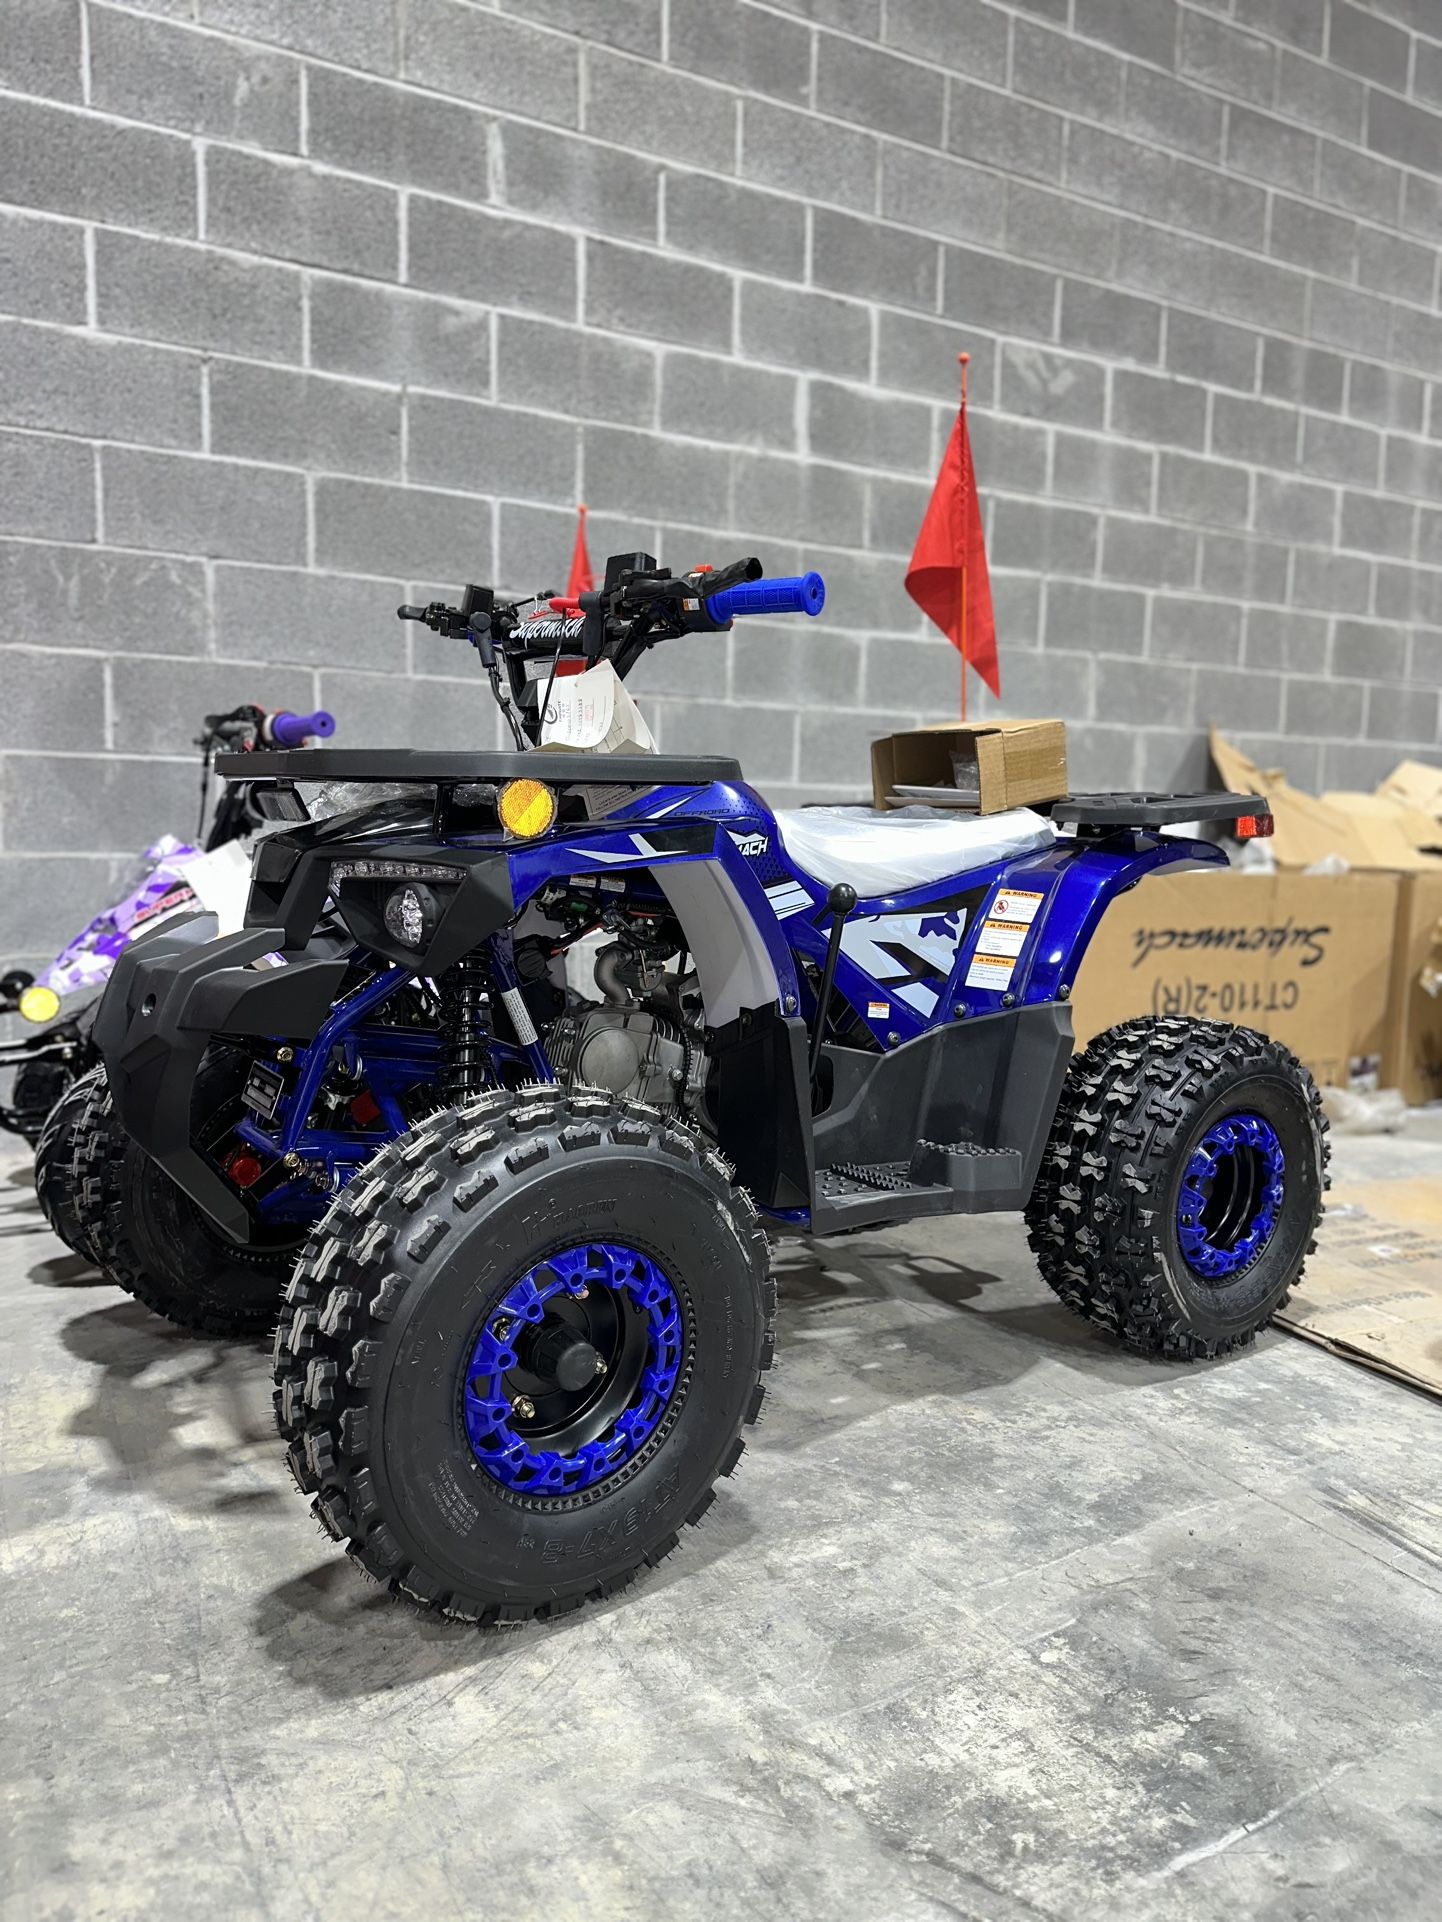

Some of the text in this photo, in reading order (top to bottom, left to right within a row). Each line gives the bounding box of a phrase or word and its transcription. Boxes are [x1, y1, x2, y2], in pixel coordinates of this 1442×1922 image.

[673, 808, 730, 817] OFFROAD
[1012, 891, 1038, 899] WARNING
[997, 923, 1023, 931] WARNING
[1131, 916, 1331, 968] Supermach
[985, 958, 1010, 966] WARNING
[1151, 978, 1299, 1015] CT110-2(R)
